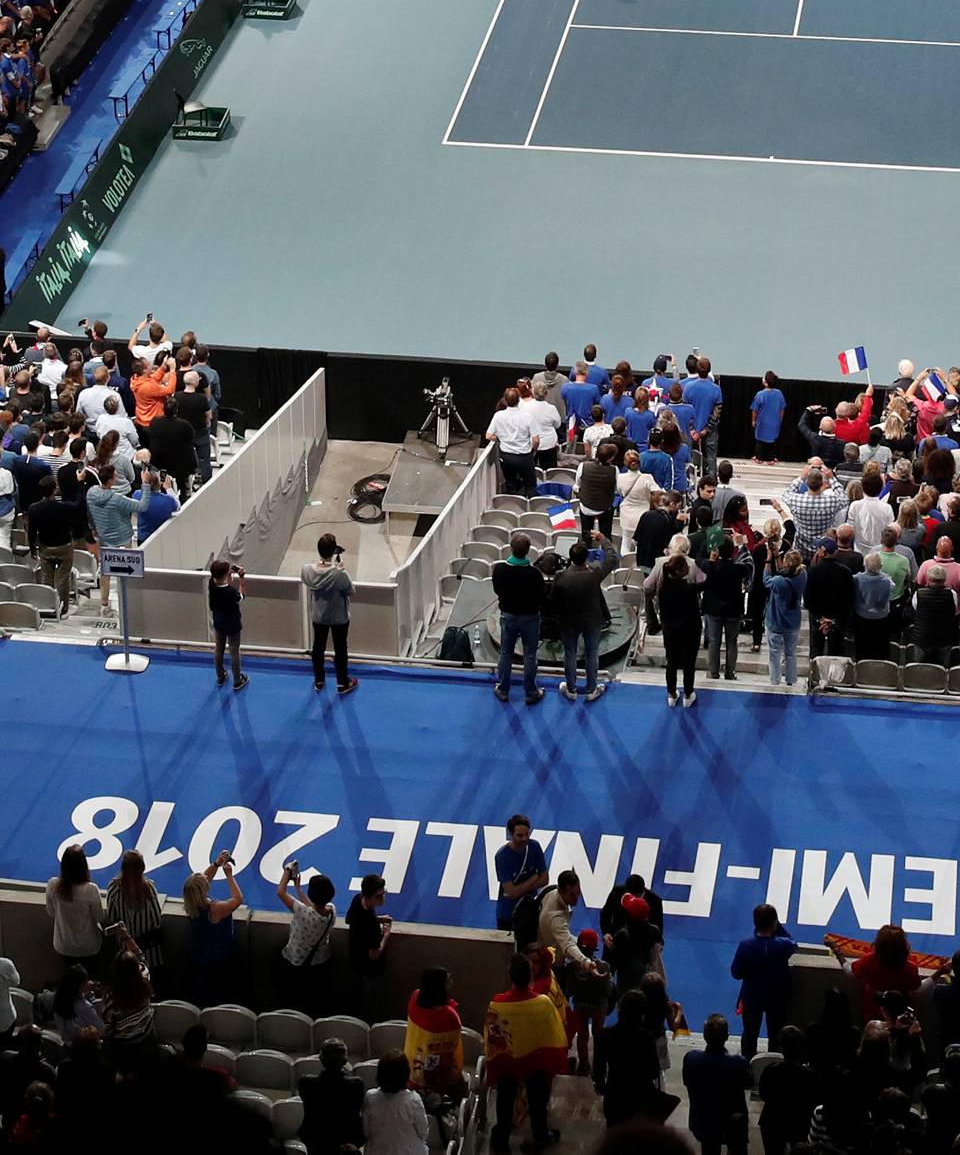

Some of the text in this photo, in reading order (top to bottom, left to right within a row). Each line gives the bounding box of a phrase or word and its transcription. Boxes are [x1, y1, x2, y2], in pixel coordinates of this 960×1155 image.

[192, 45, 214, 79] JAGUAR
[104, 555, 141, 564] ARENA SUD
